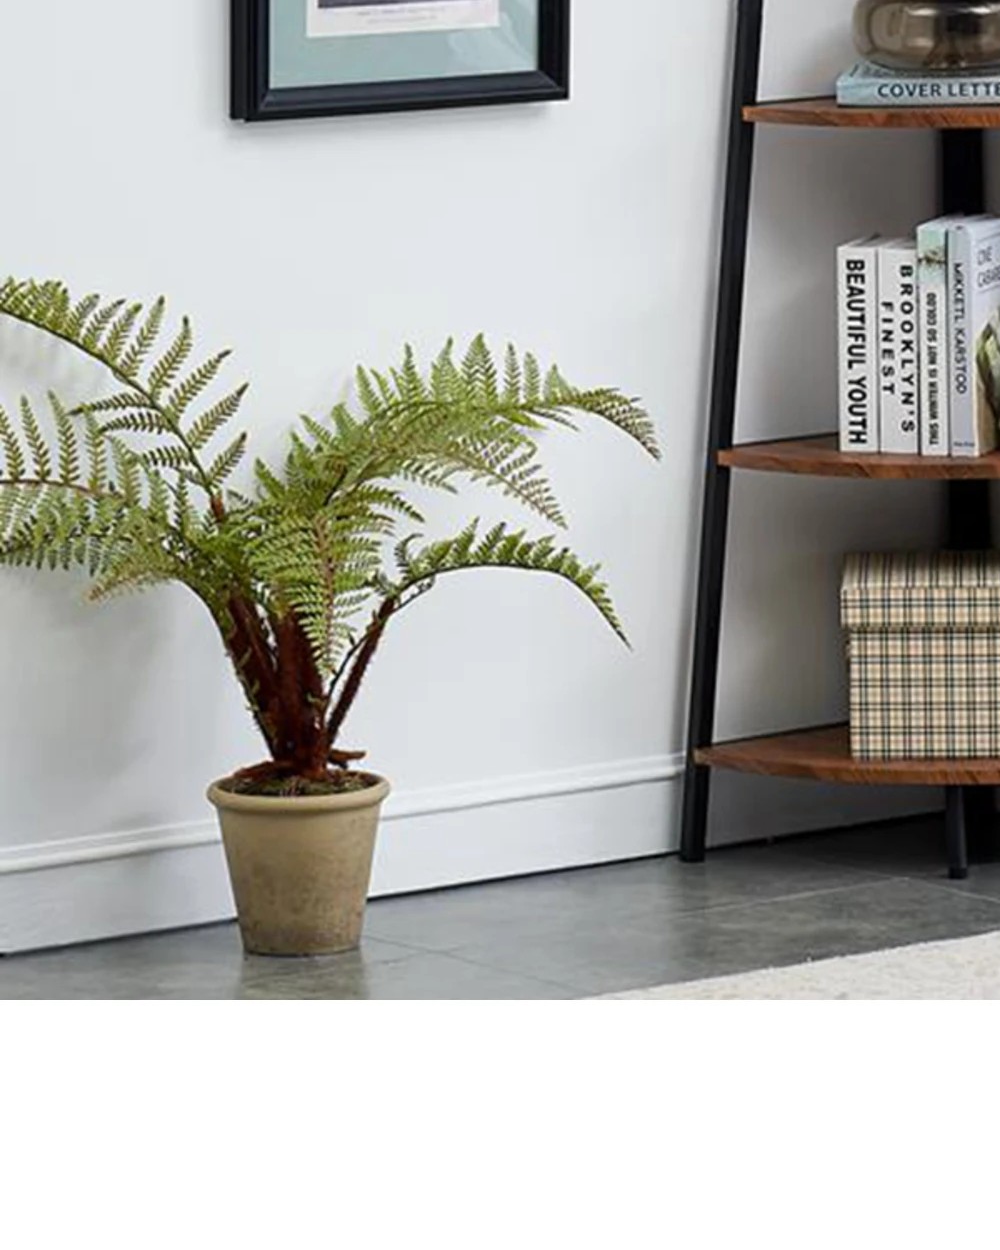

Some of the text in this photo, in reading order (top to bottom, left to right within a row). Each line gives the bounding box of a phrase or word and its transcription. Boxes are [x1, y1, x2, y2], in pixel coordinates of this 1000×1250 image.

[877, 82, 942, 98] COVER
[846, 259, 867, 444] BEAUTIFUL YOUTH
[881, 302, 895, 395] FINEST
[900, 265, 915, 432] BROOKLYN'S
[926, 328, 937, 343] SO
[927, 345, 937, 365] NOT
